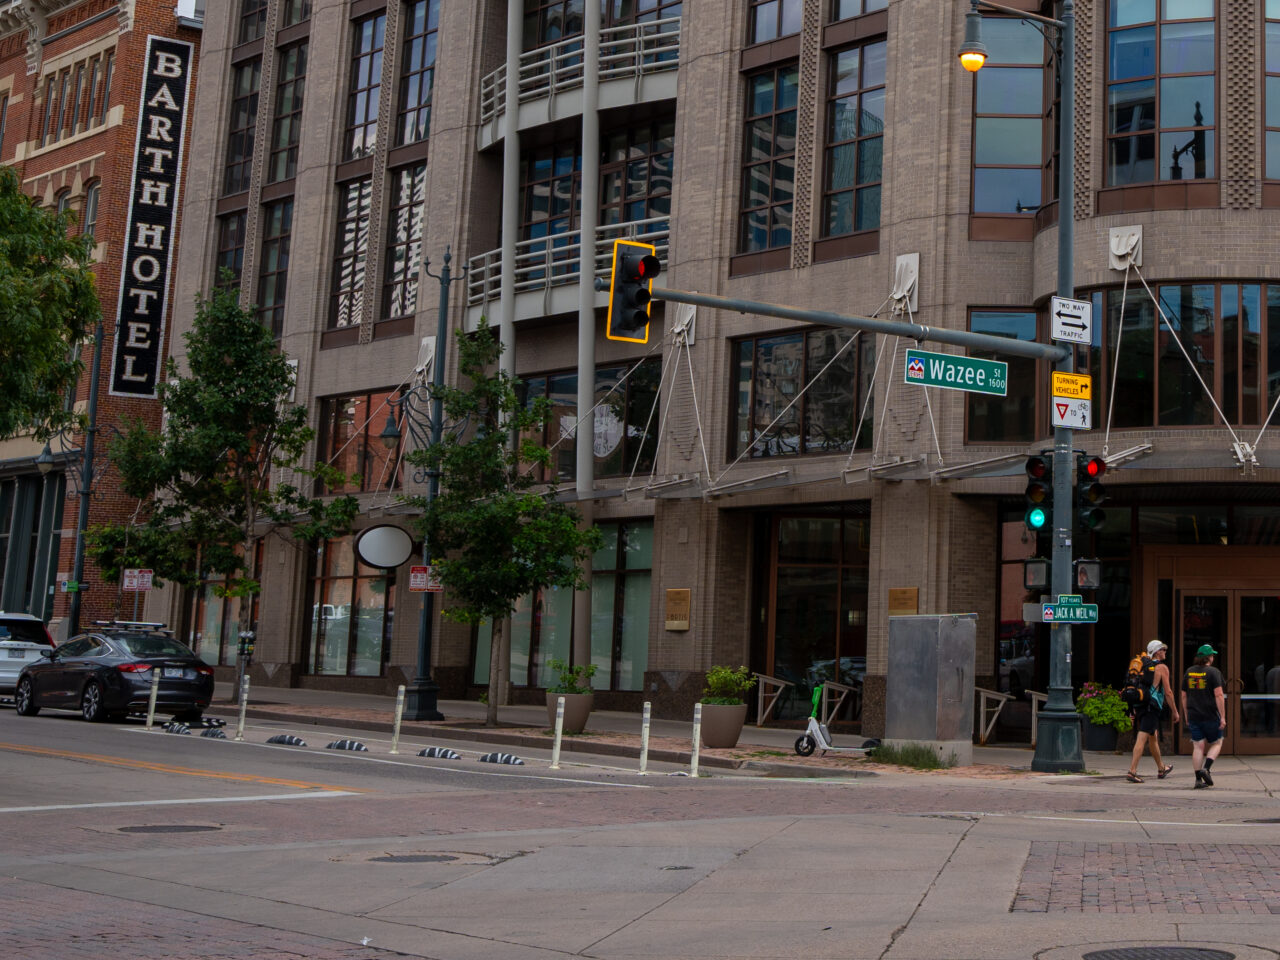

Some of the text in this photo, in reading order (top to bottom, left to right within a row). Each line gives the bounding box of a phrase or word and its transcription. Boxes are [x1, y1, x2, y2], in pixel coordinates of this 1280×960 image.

[122, 51, 182, 382] BARTH HOTEL
[1058, 302, 1085, 312] TWO WAY
[1060, 330, 1083, 339] TRAFFIC
[929, 358, 986, 386] Wazee
[989, 378, 1006, 389] 1600
[1056, 377, 1079, 386] TURNING
[1055, 386, 1079, 395] VEHICLES
[1070, 409, 1077, 417] TO
[1054, 607, 1069, 618] JACK
